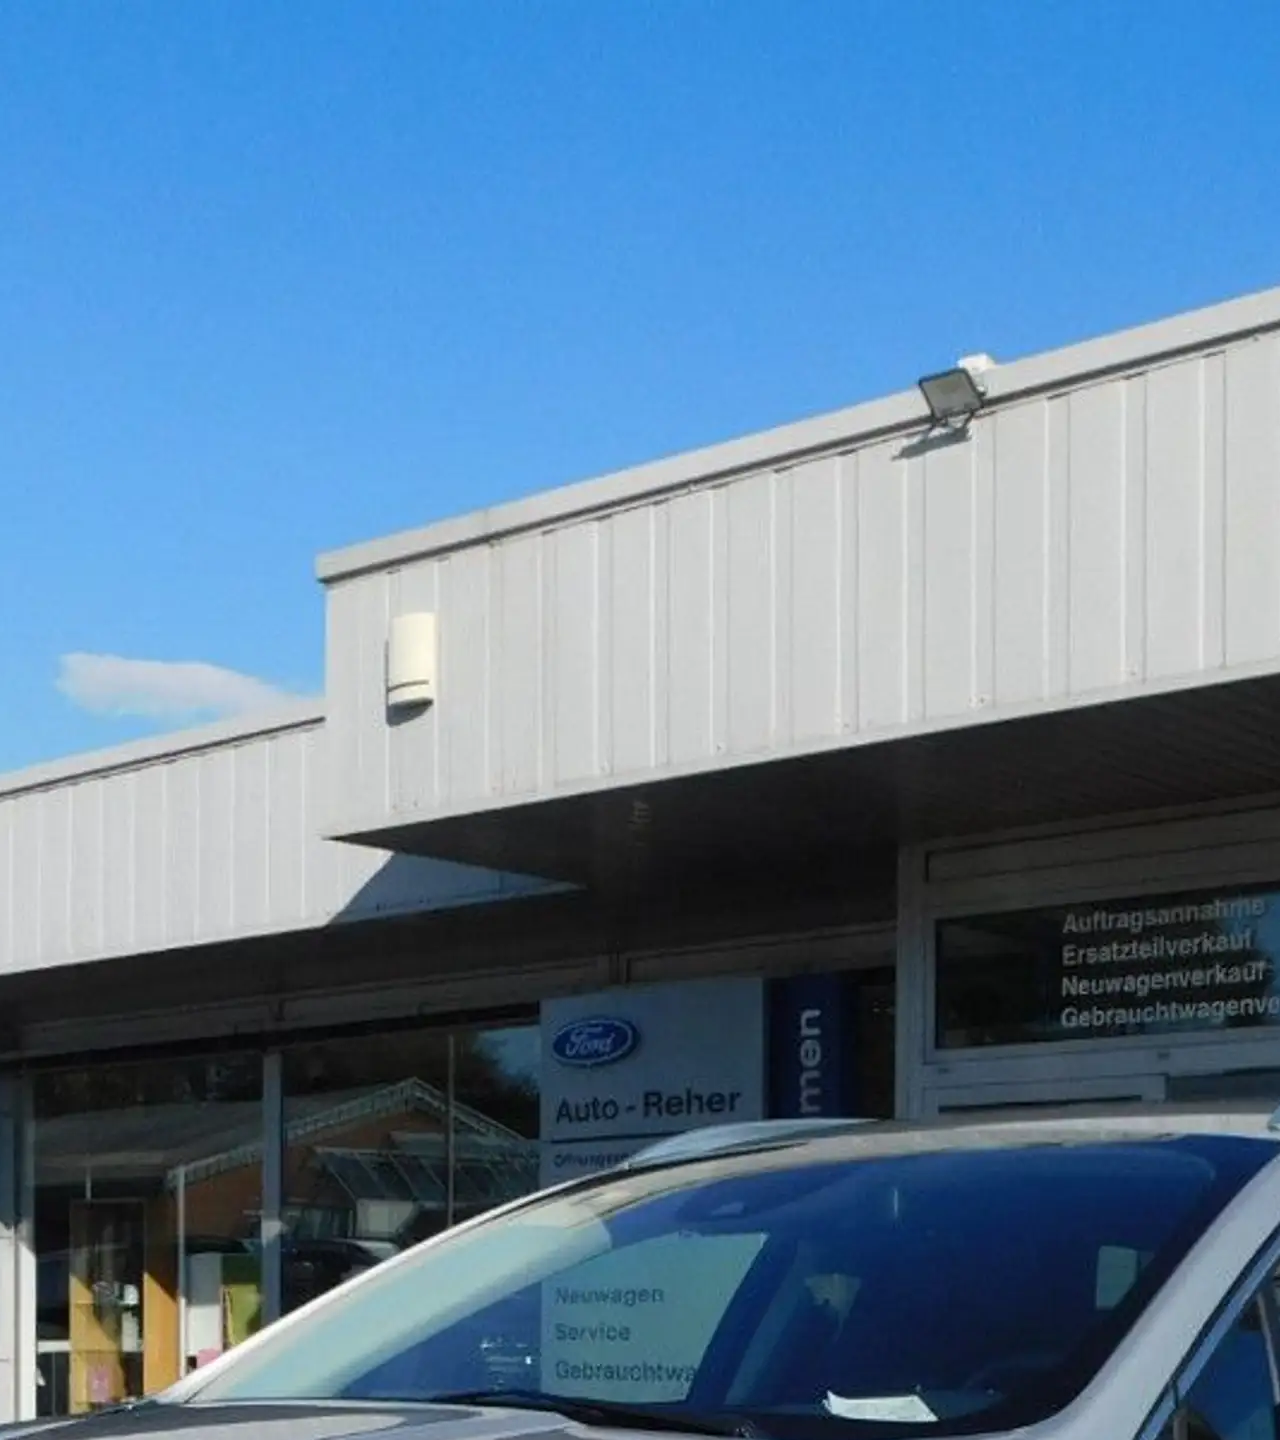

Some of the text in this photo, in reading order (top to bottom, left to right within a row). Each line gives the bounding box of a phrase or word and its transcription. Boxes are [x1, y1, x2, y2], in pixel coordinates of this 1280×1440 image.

[1062, 897, 1265, 933] Auftragsannahme
[1062, 927, 1255, 966] Ersatzteilverkauf
[1061, 960, 1267, 996] Neuwagenverkauf
[564, 1025, 615, 1057] Ford
[643, 1088, 742, 1118] Reher
[555, 1286, 665, 1307] Neuwagen
[555, 1322, 632, 1341] Service
